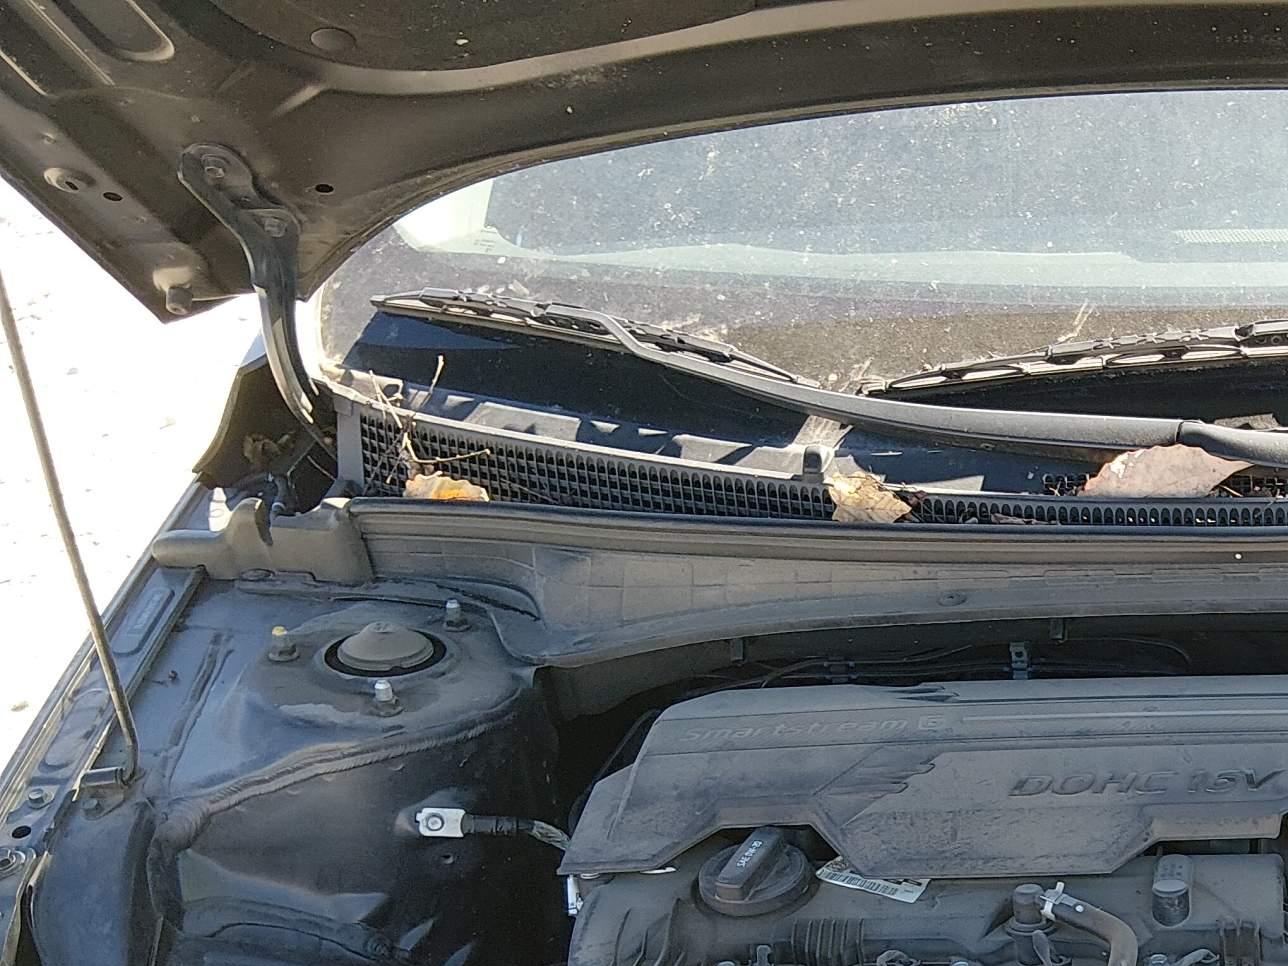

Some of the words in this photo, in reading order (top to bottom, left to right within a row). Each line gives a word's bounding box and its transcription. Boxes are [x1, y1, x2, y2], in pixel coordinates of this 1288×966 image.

[679, 714, 907, 743] Smartstream
[1008, 770, 1177, 797] DOHC
[1186, 767, 1286, 793] 16V
